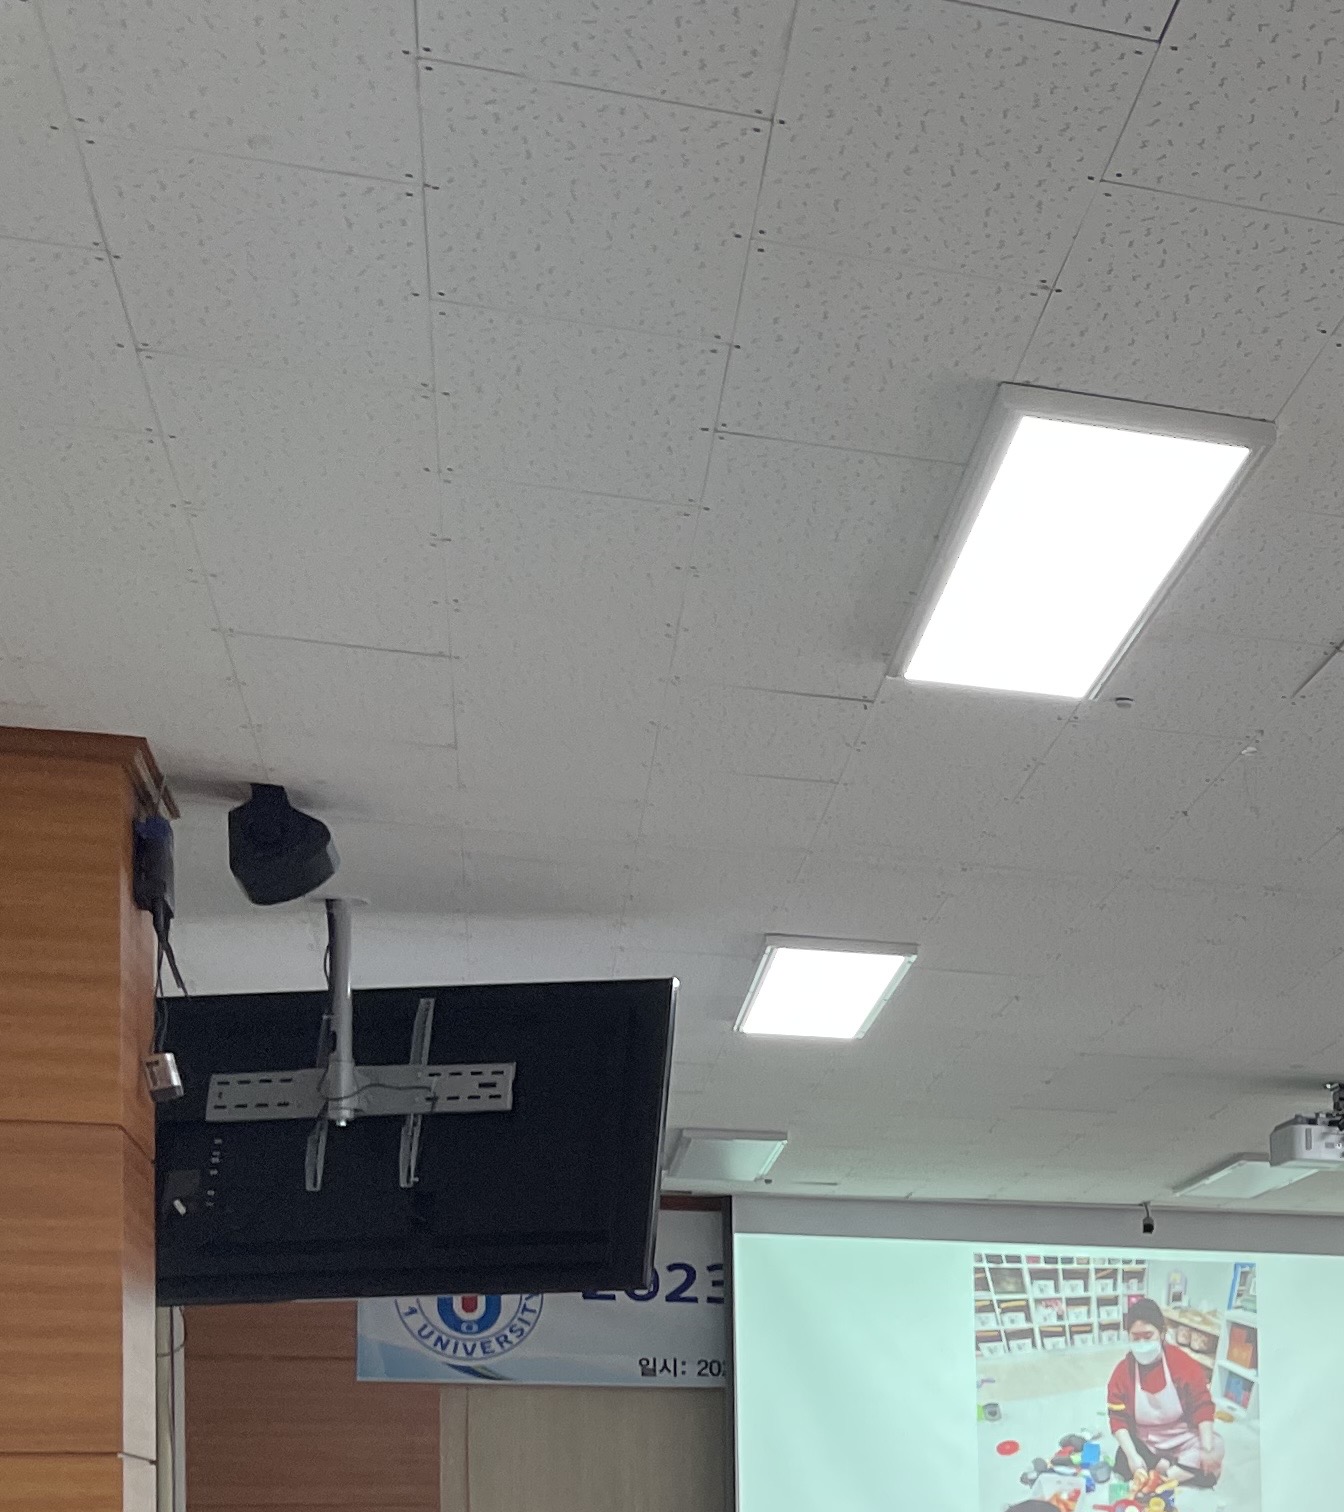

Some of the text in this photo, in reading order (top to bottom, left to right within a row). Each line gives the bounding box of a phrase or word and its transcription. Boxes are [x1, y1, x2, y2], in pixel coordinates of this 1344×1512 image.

[578, 1262, 724, 1303] 023
[417, 1292, 541, 1356] UNIVERSITY
[638, 1357, 726, 1378] 일시: 20
